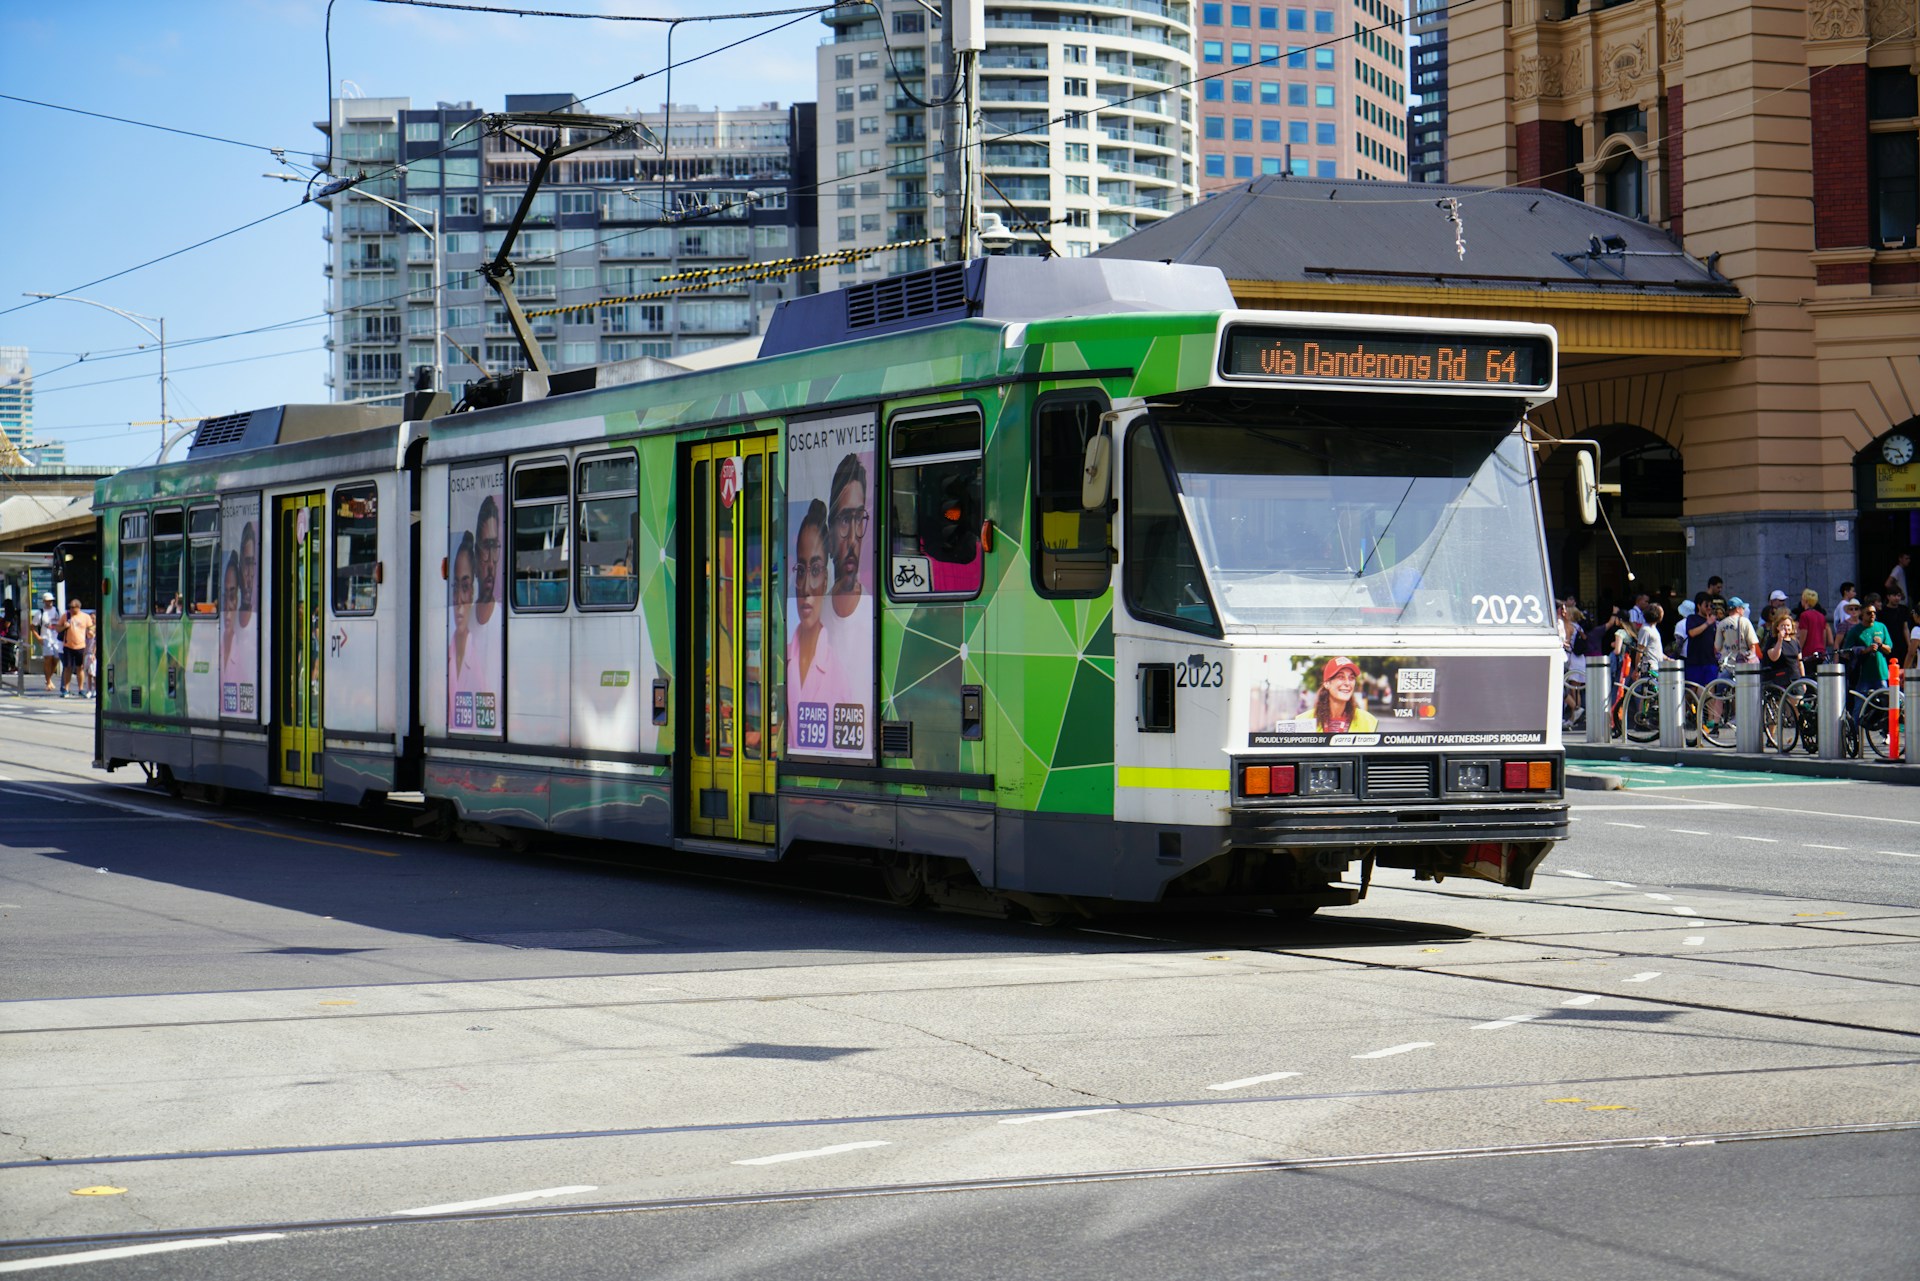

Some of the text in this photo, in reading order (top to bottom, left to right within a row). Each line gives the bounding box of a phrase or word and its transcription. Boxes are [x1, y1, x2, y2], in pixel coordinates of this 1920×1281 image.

[1261, 341, 1516, 383] via Dandenong Rd 64
[836, 424, 875, 446] WYLEE
[1878, 466, 1909, 474] LILYDALE
[1878, 474, 1893, 482] LINE
[1471, 595, 1544, 624] 2023
[1176, 661, 1224, 689] 2023
[1401, 679, 1432, 690] ISSUE
[799, 706, 827, 722] 2 PAIRS
[834, 707, 863, 723] 3 PAIRS
[1393, 708, 1413, 718] VISA
[1255, 736, 1327, 744] PROUDLY SUPPORTED BY
[1333, 736, 1351, 744] yarra
[1383, 733, 1541, 744] COMMUNITY PARTNERSHIPS PROGRAM
